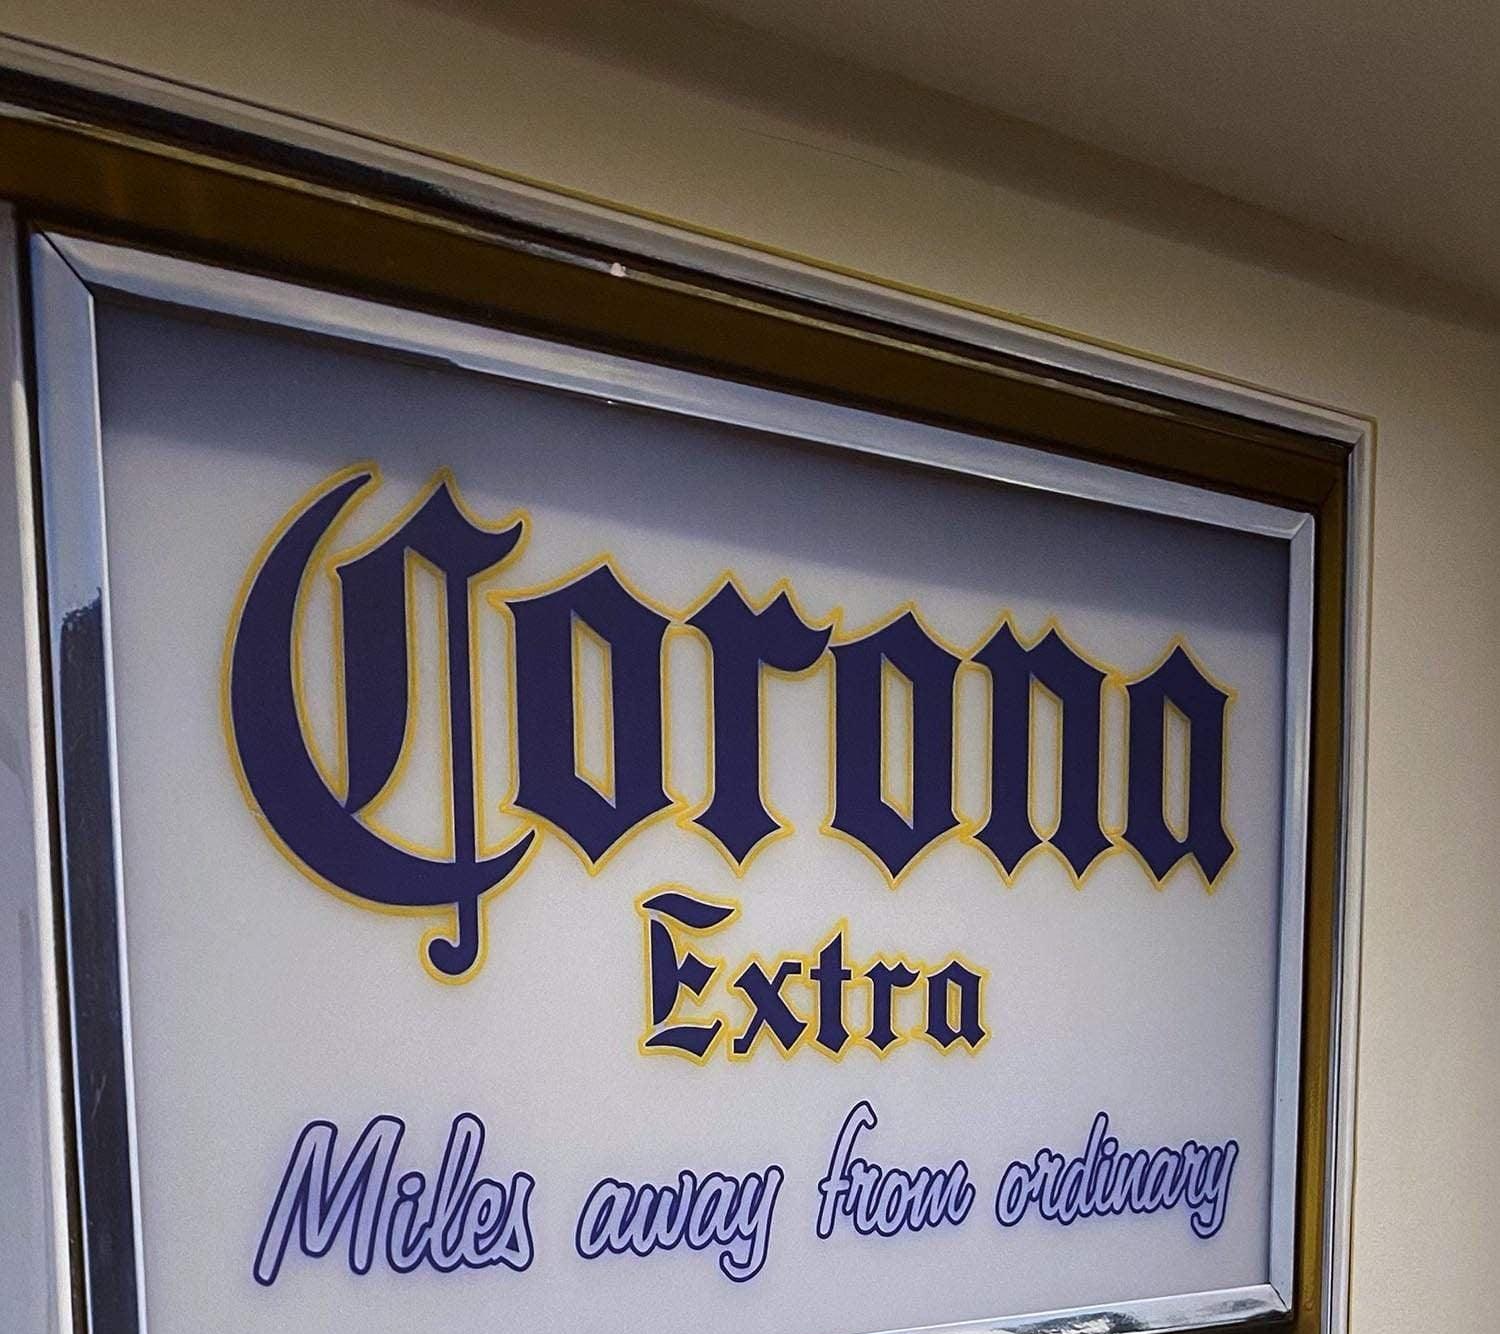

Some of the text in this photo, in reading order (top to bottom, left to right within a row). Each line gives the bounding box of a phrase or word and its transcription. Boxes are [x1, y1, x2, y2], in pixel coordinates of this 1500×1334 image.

[224, 464, 1237, 985] Corona
[639, 885, 991, 1060] Extra
[253, 1100, 1239, 1287] Miles away from ordinary
